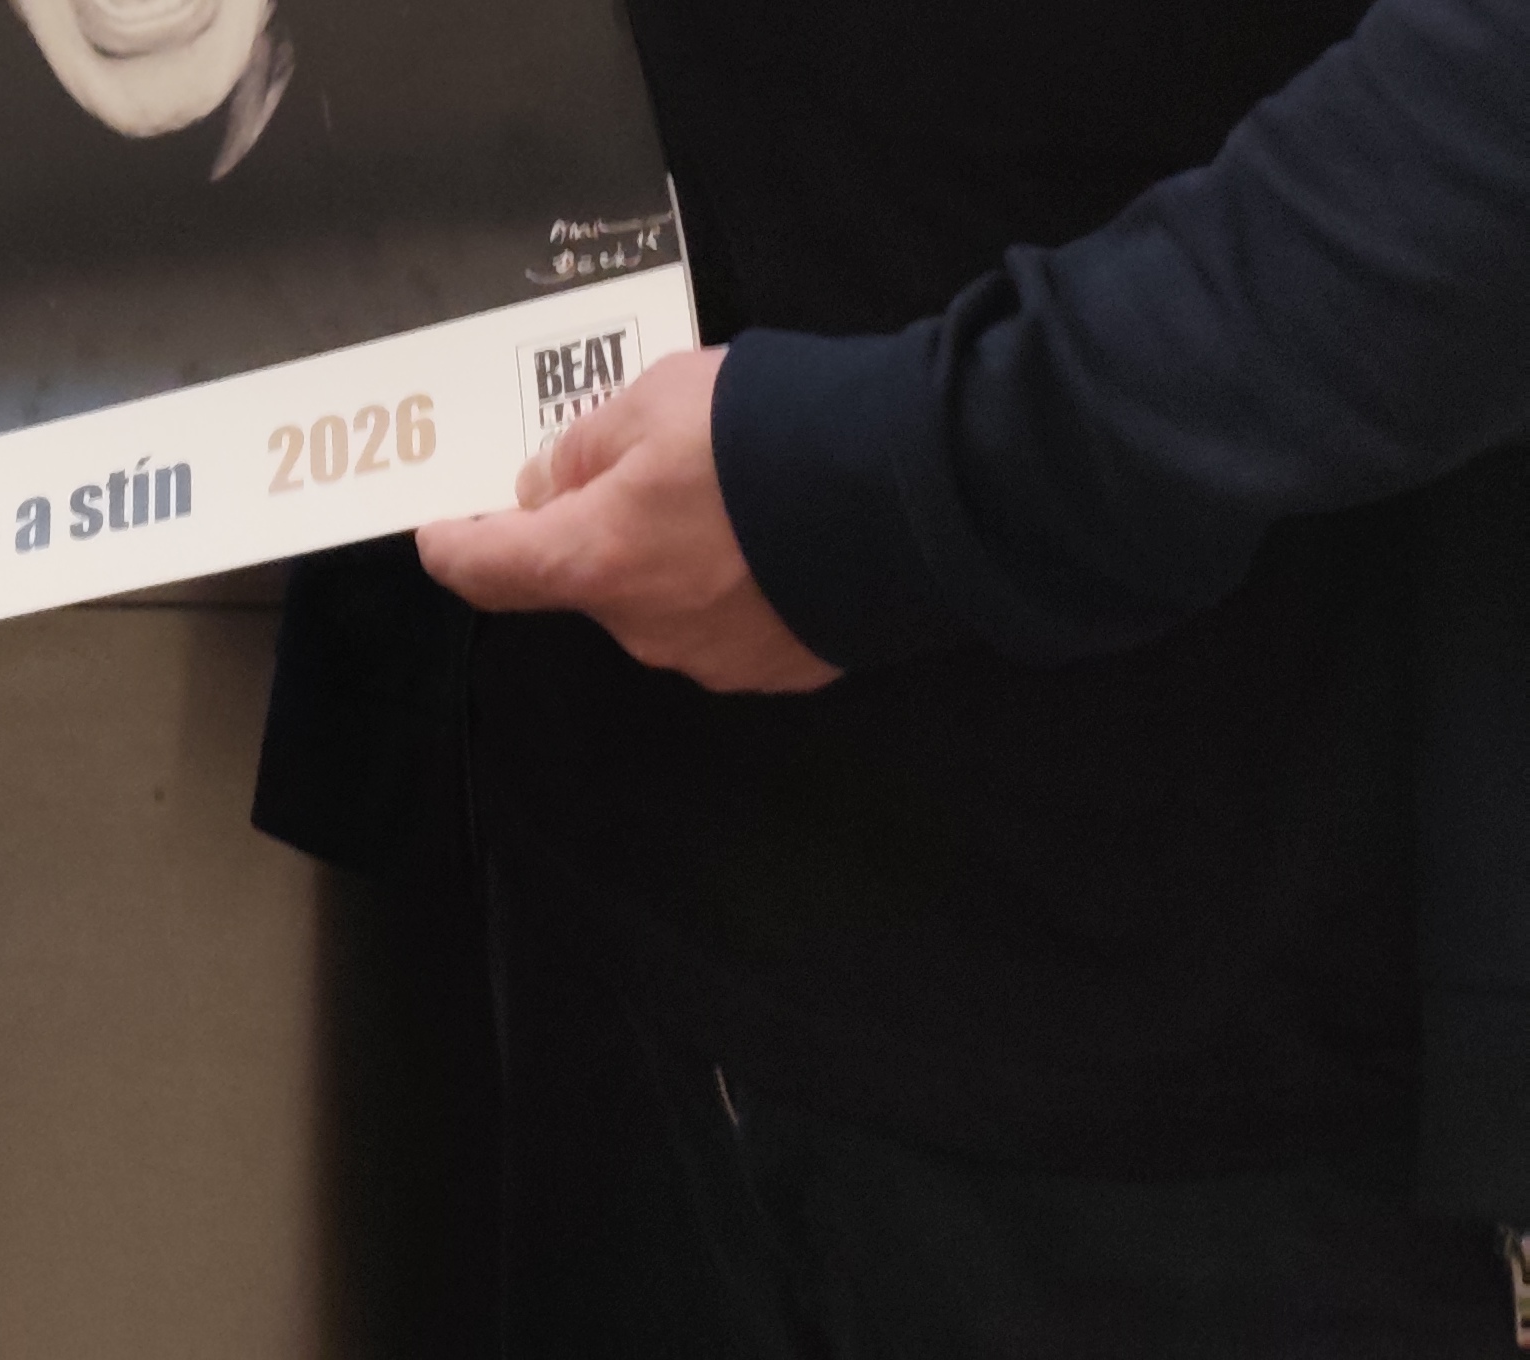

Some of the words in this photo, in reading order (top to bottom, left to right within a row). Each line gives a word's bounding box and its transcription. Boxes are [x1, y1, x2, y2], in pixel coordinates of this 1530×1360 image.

[533, 328, 626, 404] BEAT
[14, 494, 52, 554] a
[69, 454, 193, 543] stín
[267, 392, 437, 497] 2026
